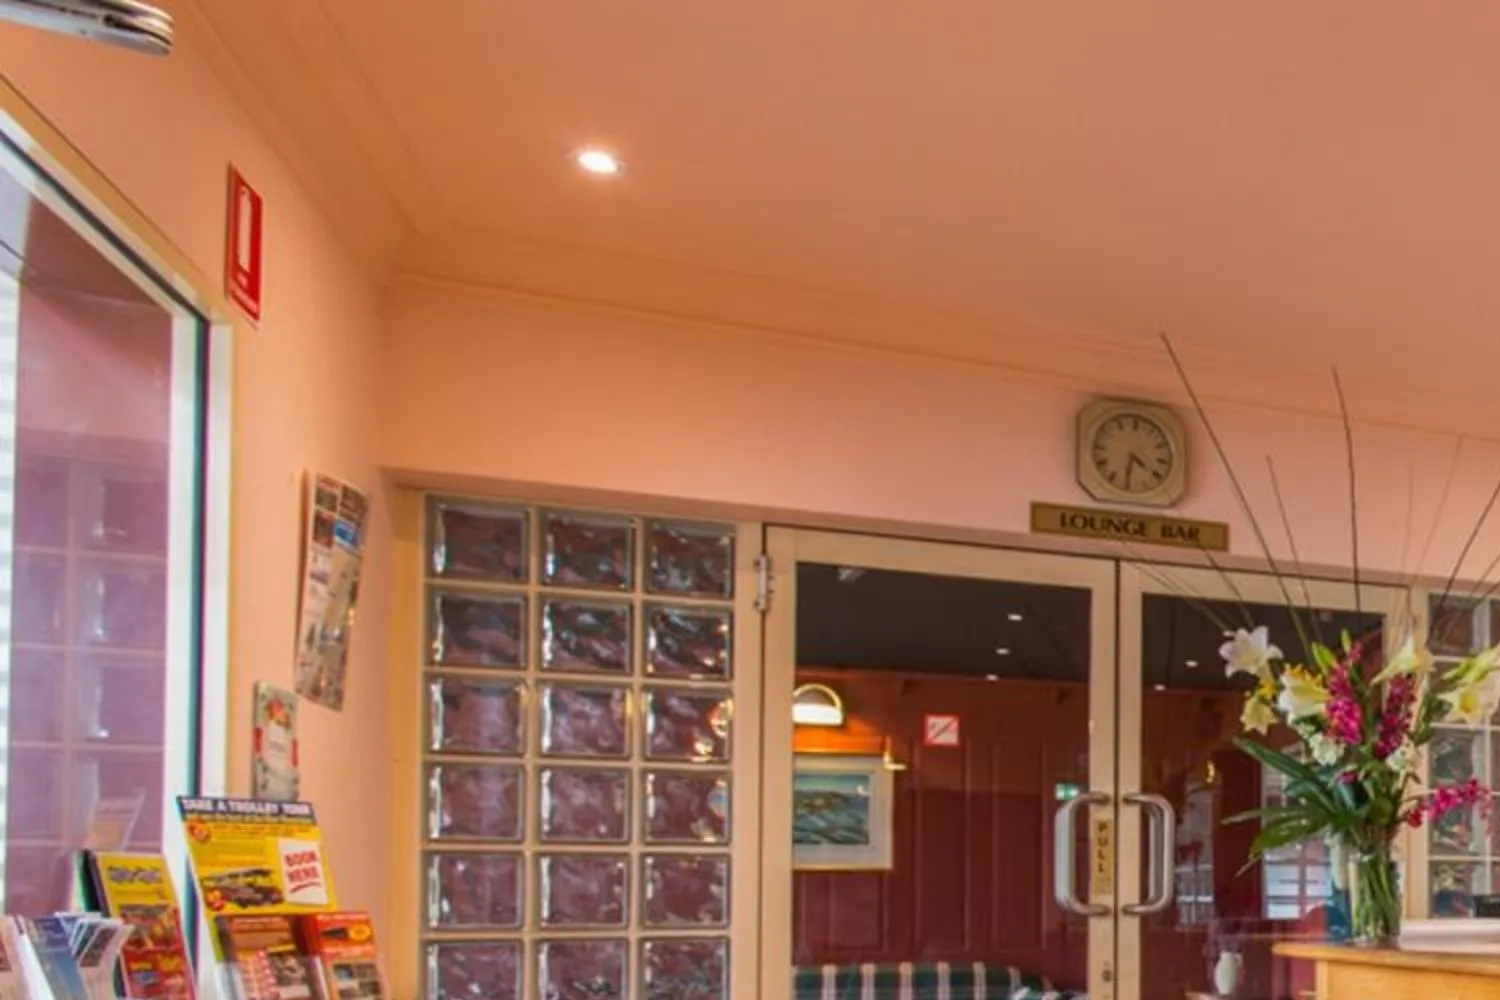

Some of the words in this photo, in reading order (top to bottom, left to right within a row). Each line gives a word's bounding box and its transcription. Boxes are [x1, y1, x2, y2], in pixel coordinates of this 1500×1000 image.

[1060, 512, 1146, 536] LOUNGE
[1160, 524, 1201, 542] BAR
[1098, 821, 1108, 873] PULL
[285, 851, 317, 867] BOOK
[287, 867, 319, 882] HERE
